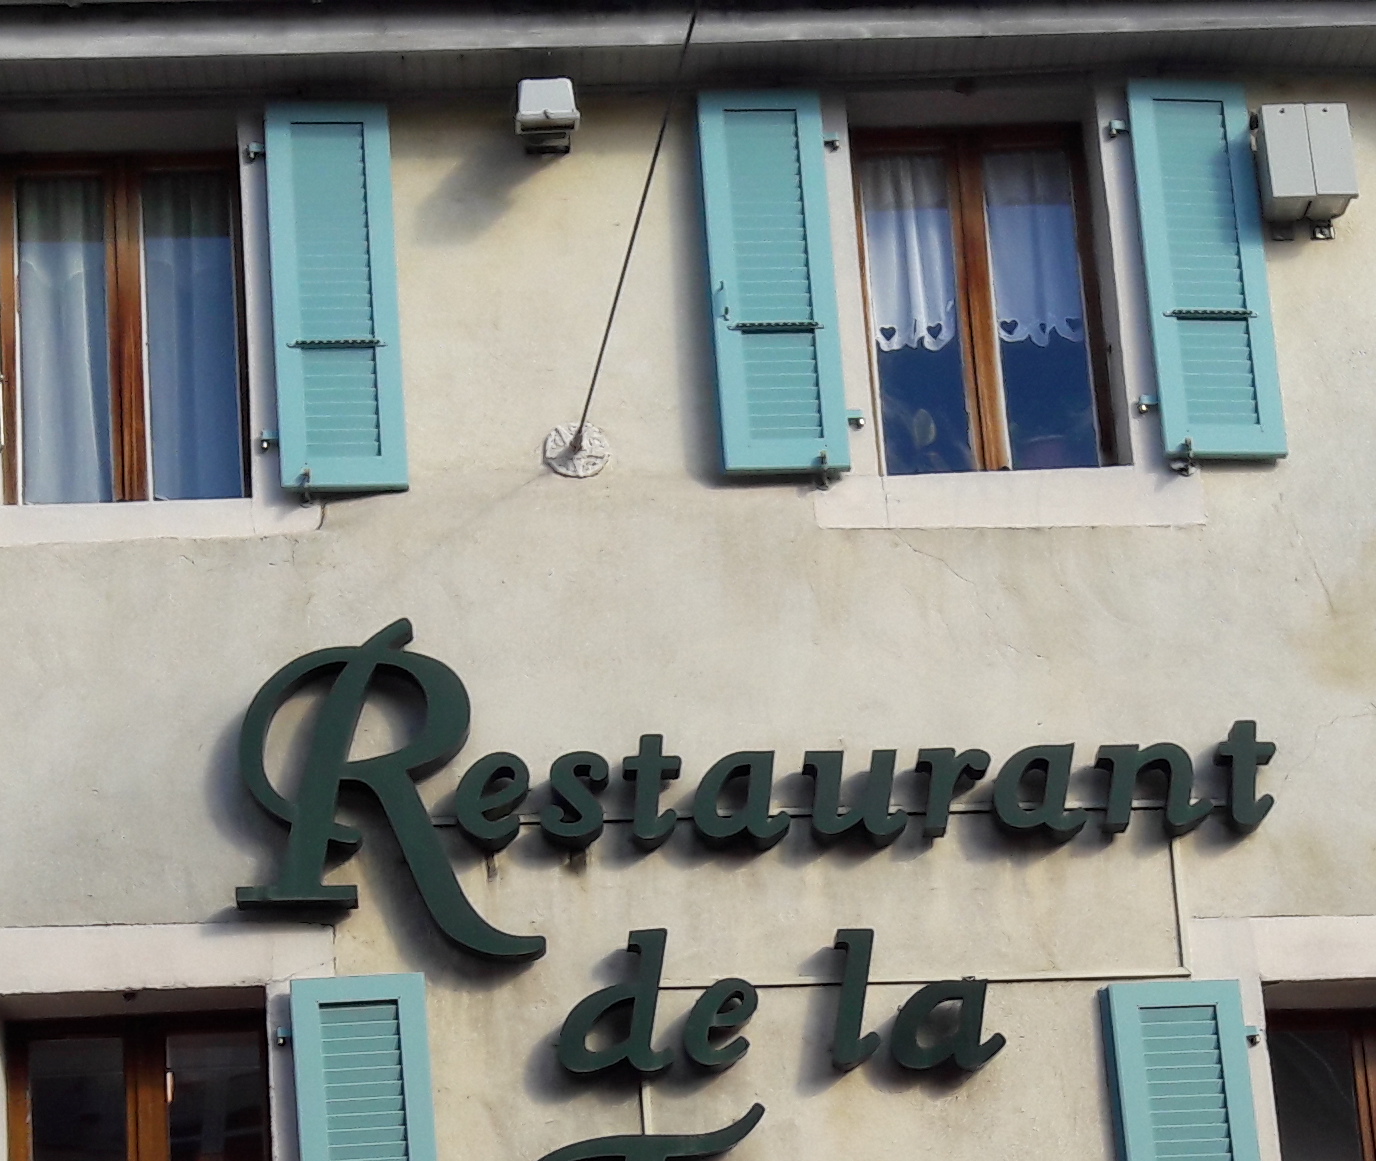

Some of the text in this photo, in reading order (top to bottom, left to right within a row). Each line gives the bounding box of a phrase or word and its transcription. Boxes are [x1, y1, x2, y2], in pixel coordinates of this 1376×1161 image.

[234, 617, 1277, 962] Restaurant
[557, 927, 1007, 1080] de la
